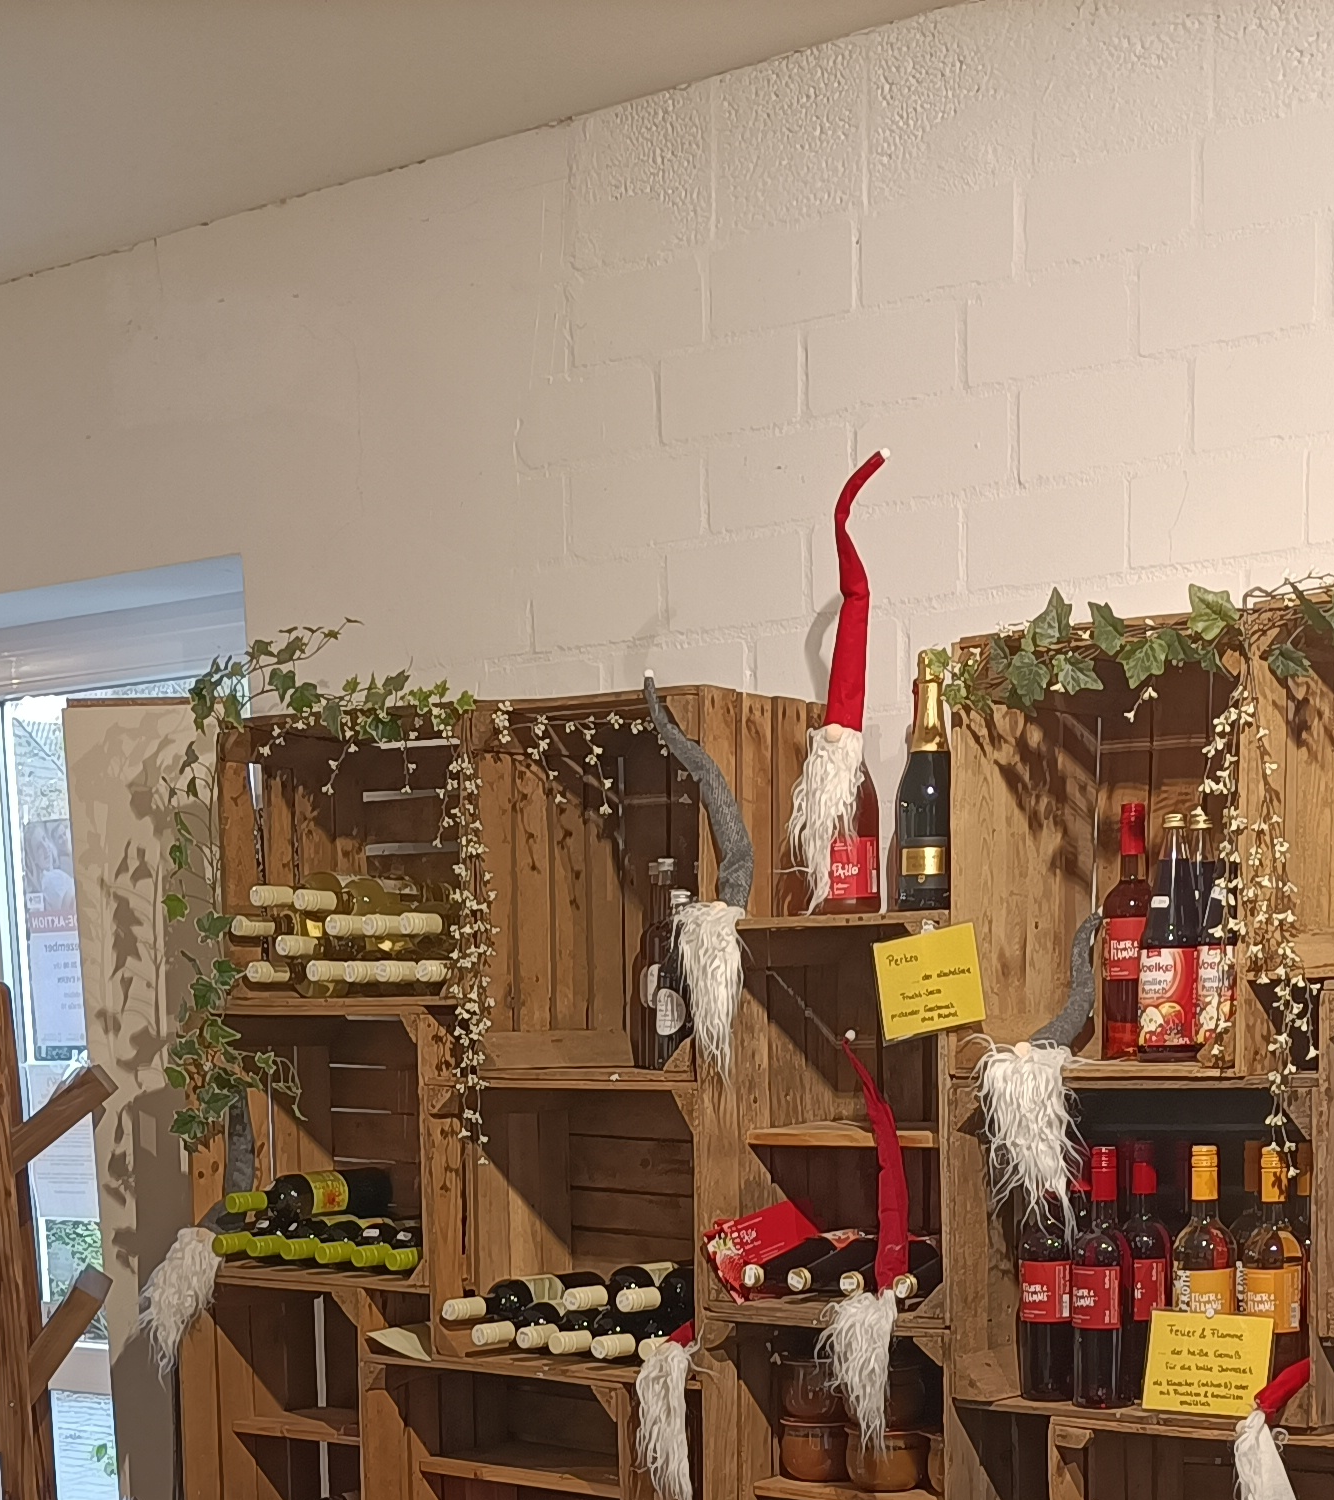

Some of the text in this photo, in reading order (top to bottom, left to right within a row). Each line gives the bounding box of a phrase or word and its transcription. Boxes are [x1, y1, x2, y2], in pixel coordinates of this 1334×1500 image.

[1167, 1324, 1244, 1341] Feuer & Flamme
